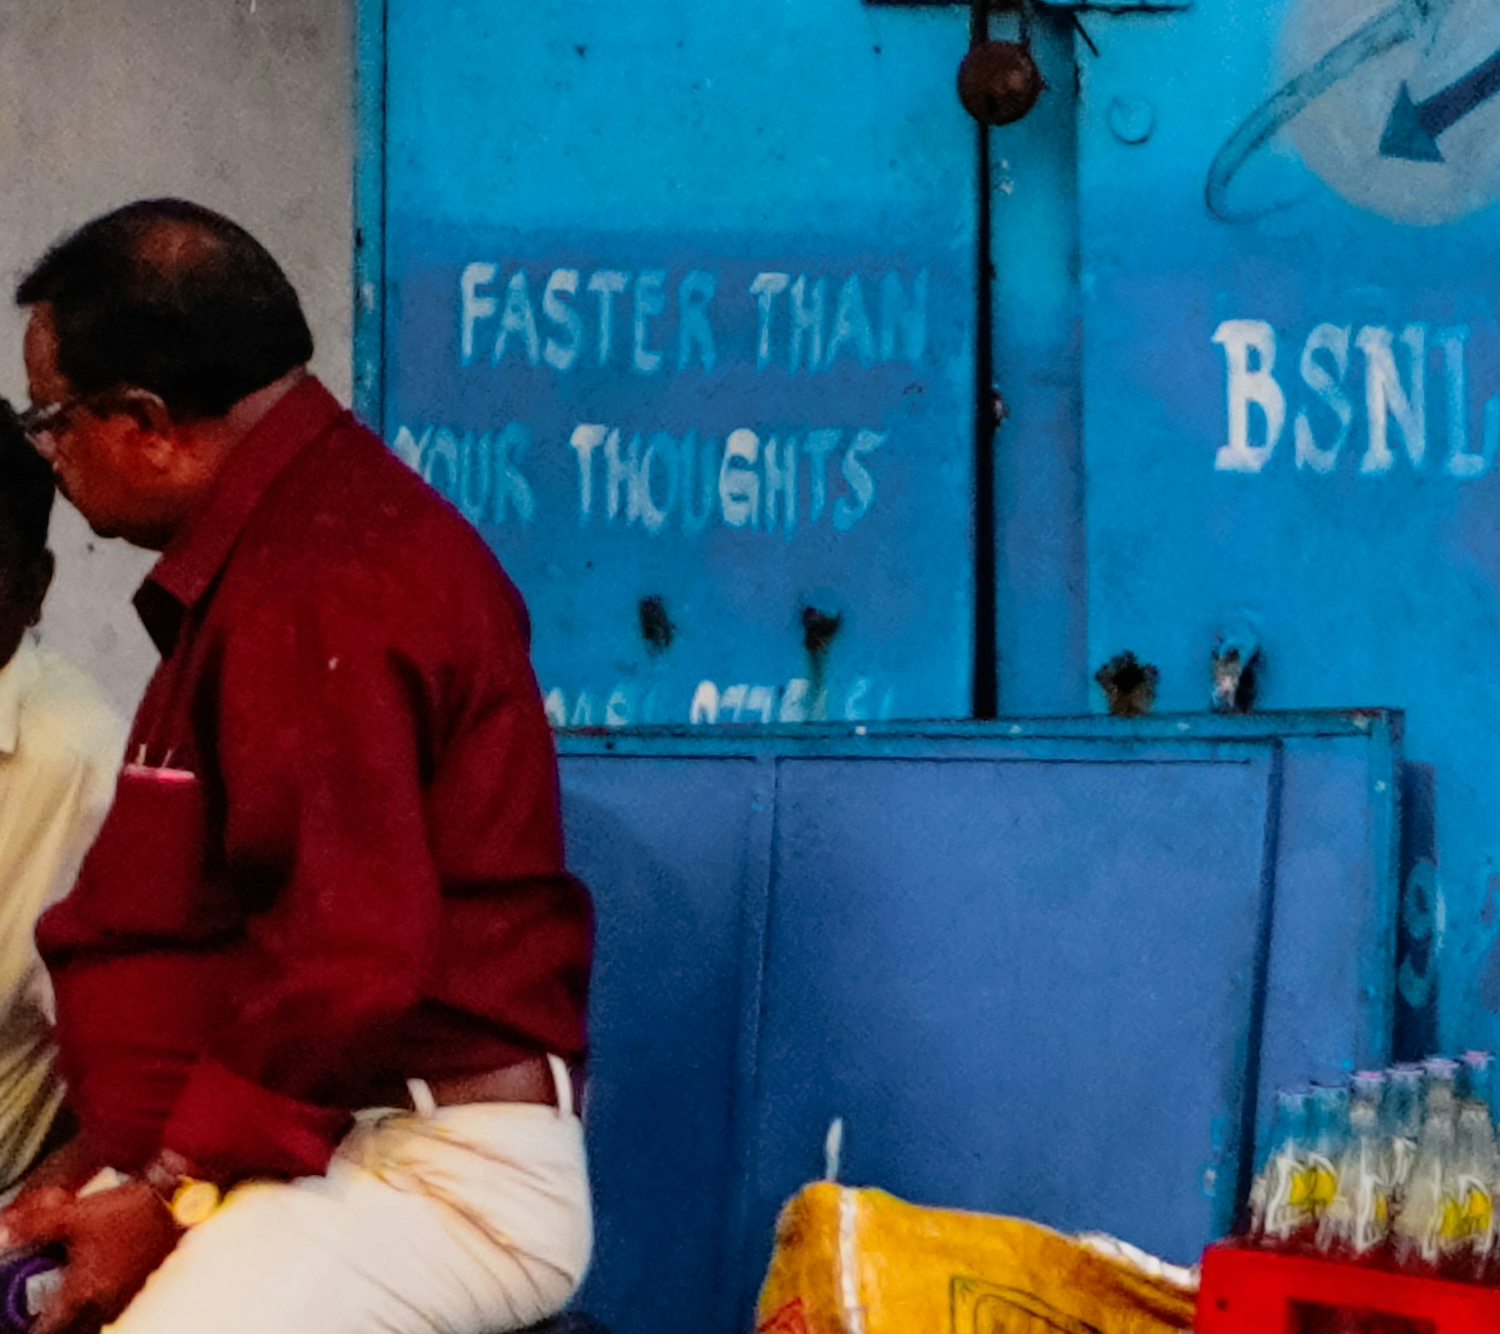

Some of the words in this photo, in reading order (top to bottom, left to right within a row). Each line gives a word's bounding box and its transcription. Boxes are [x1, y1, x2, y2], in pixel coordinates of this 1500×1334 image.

[460, 262, 716, 371] FASTER
[749, 268, 927, 373] THAN
[1212, 318, 1500, 482] BSNL
[569, 422, 891, 540] THOUGHTS
